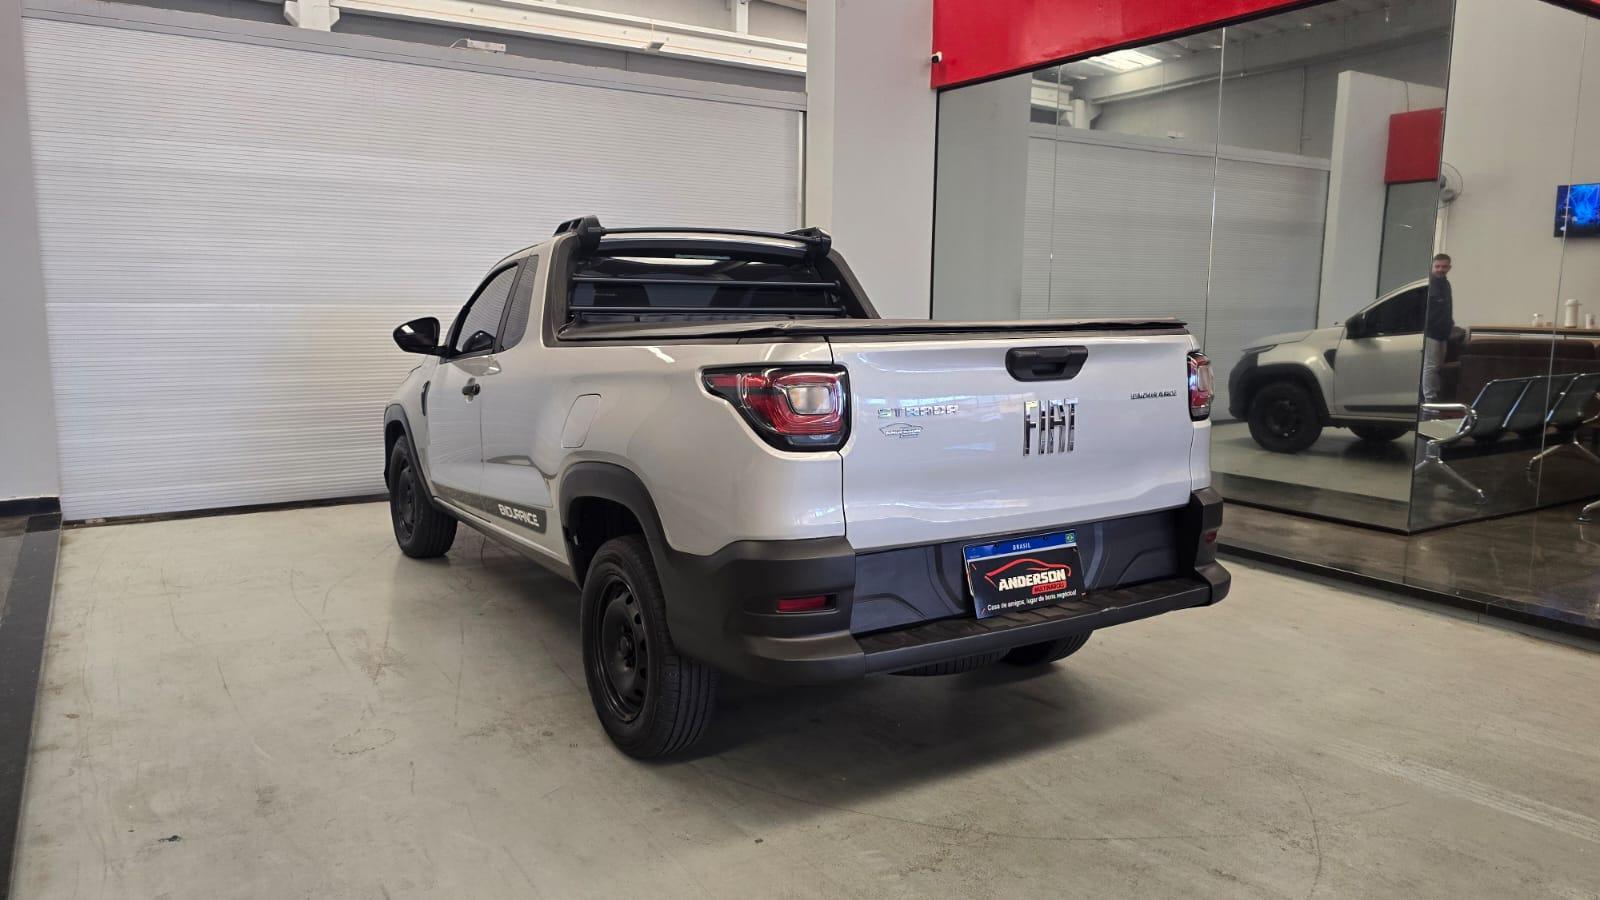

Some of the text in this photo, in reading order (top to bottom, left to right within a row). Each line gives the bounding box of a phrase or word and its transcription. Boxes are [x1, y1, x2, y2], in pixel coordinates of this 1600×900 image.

[878, 404, 959, 418] STRADA
[1023, 398, 1078, 456] FIAT
[1012, 542, 1031, 551] BRASIL
[999, 569, 1066, 591] ANDERSON
